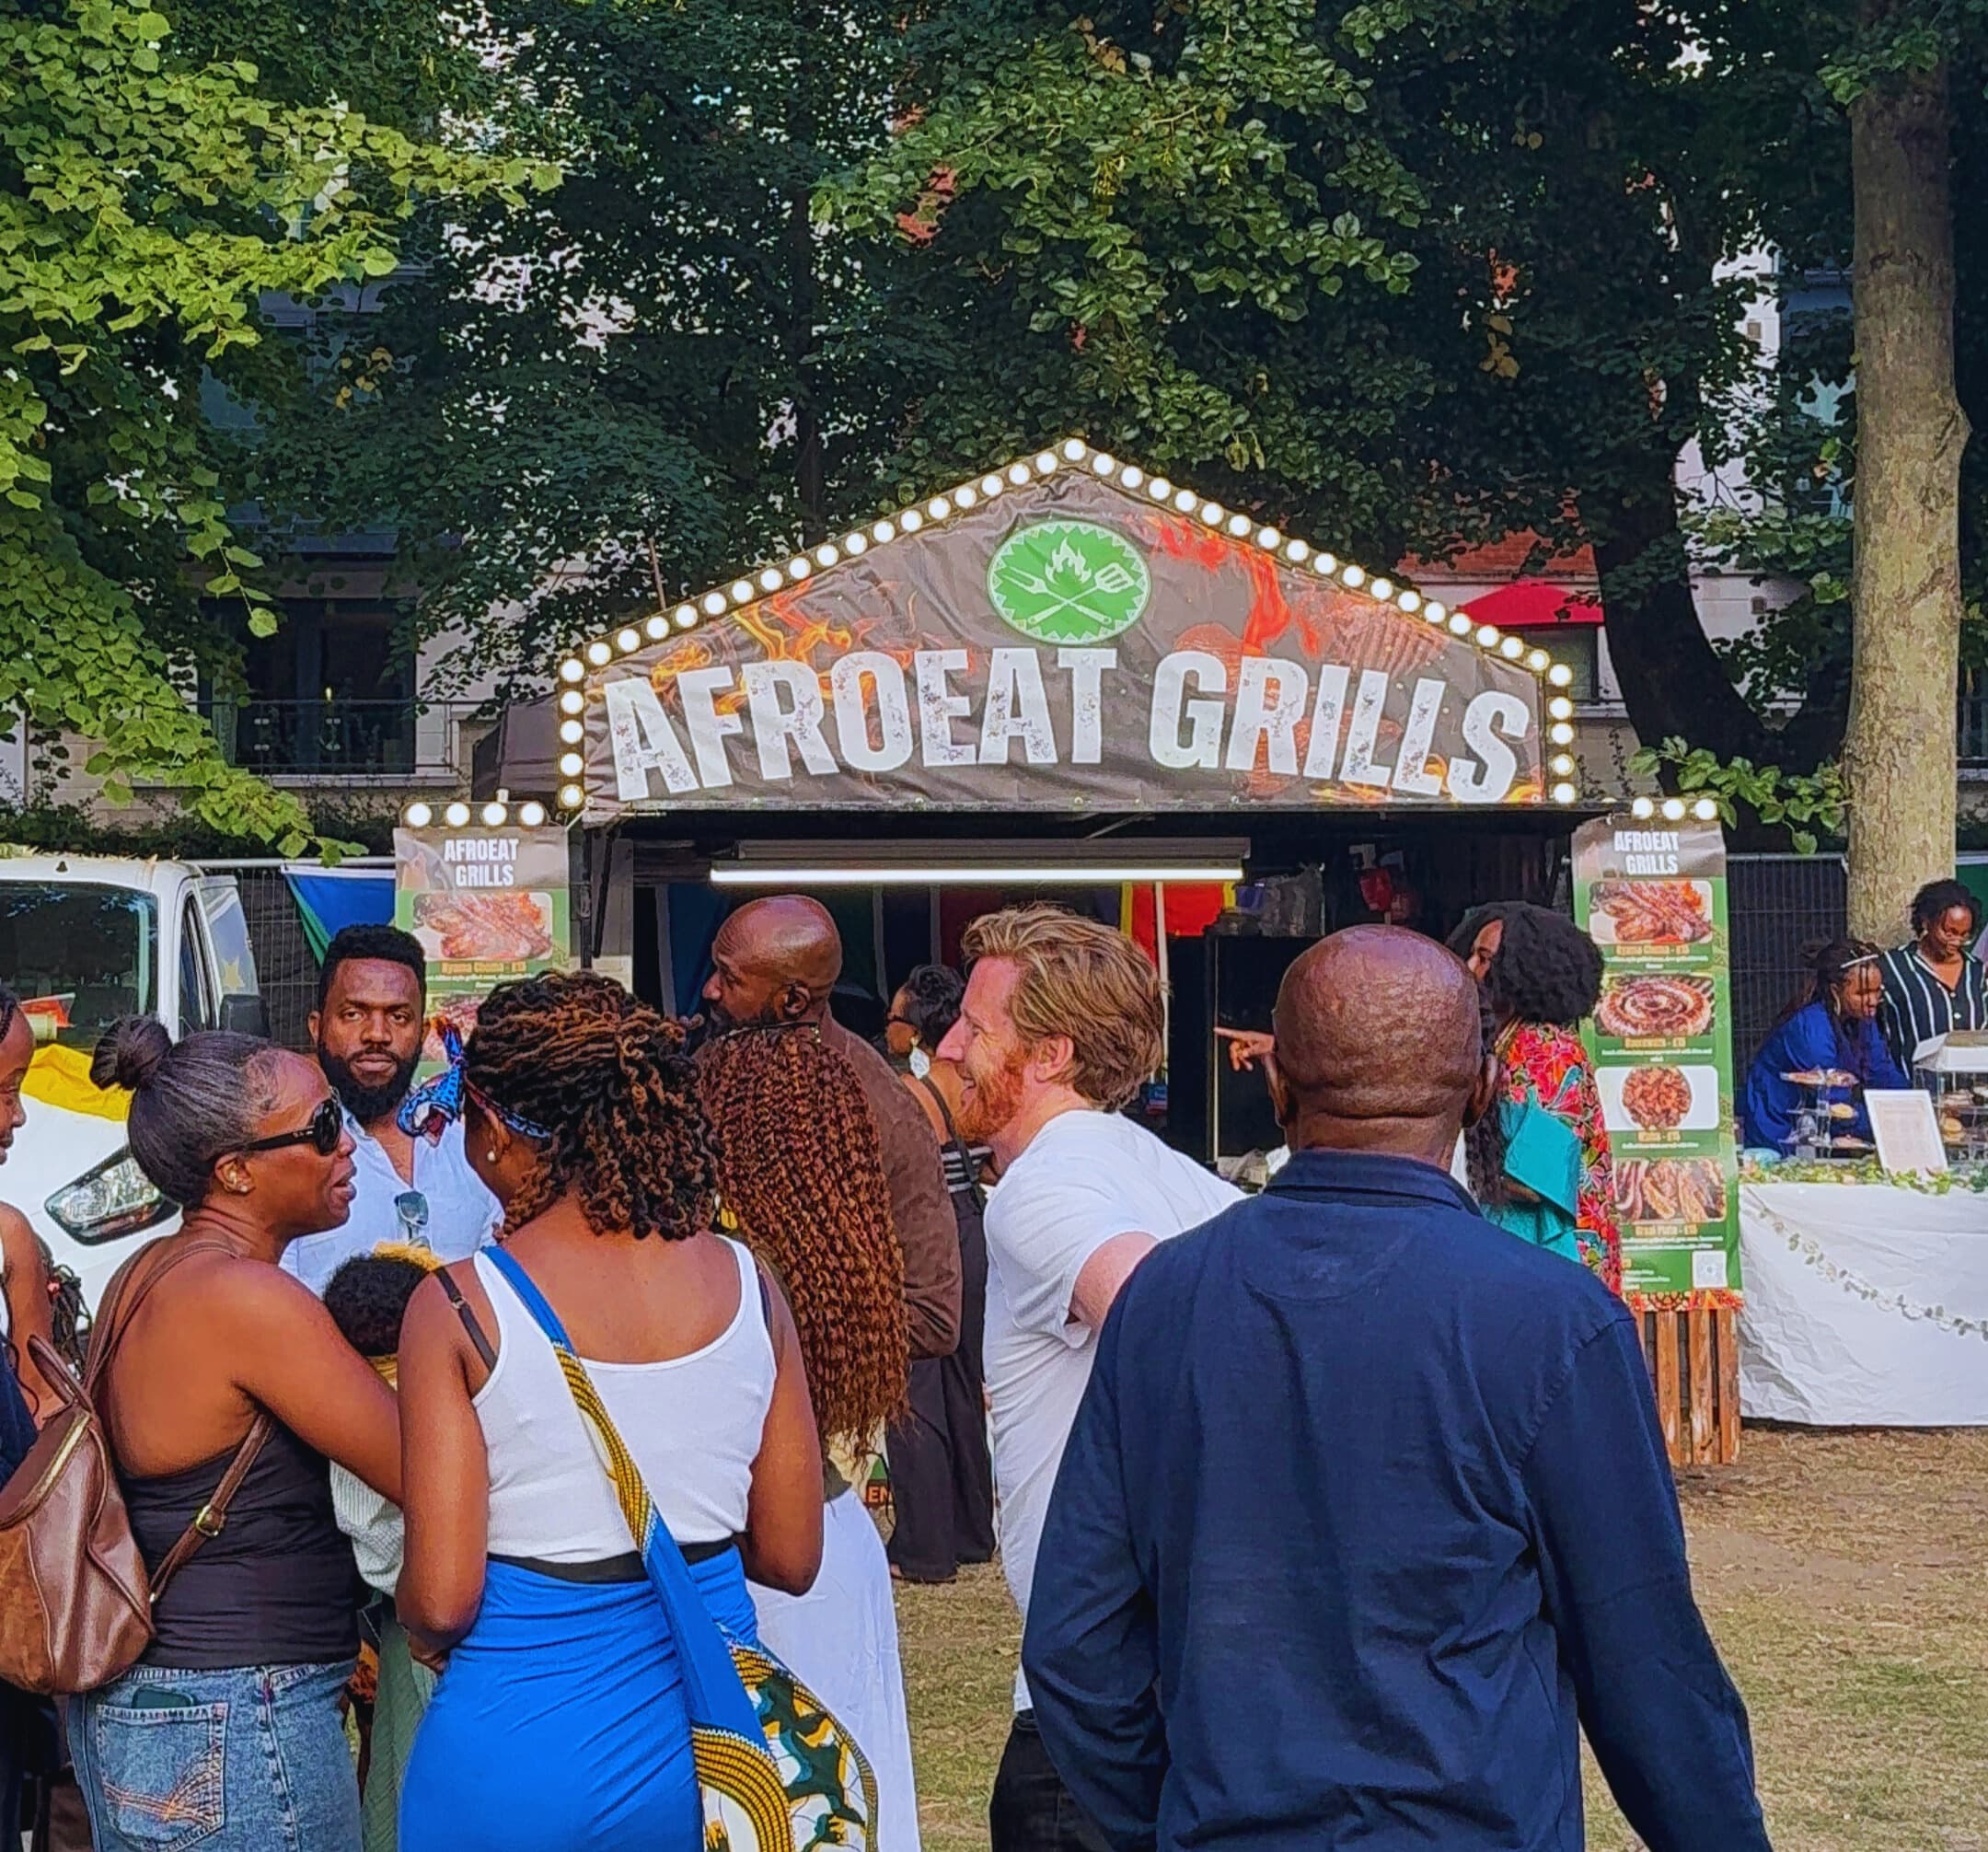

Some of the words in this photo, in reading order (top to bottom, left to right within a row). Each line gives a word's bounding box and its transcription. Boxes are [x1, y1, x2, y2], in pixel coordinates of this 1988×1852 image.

[604, 647, 1118, 801] AFROEAT
[1149, 652, 1531, 804] GRILLS
[445, 839, 517, 862] AFROEAT
[1613, 831, 1679, 852] AFROEAT
[456, 864, 514, 886] GRILLS
[1625, 853, 1679, 875] GRILLS
